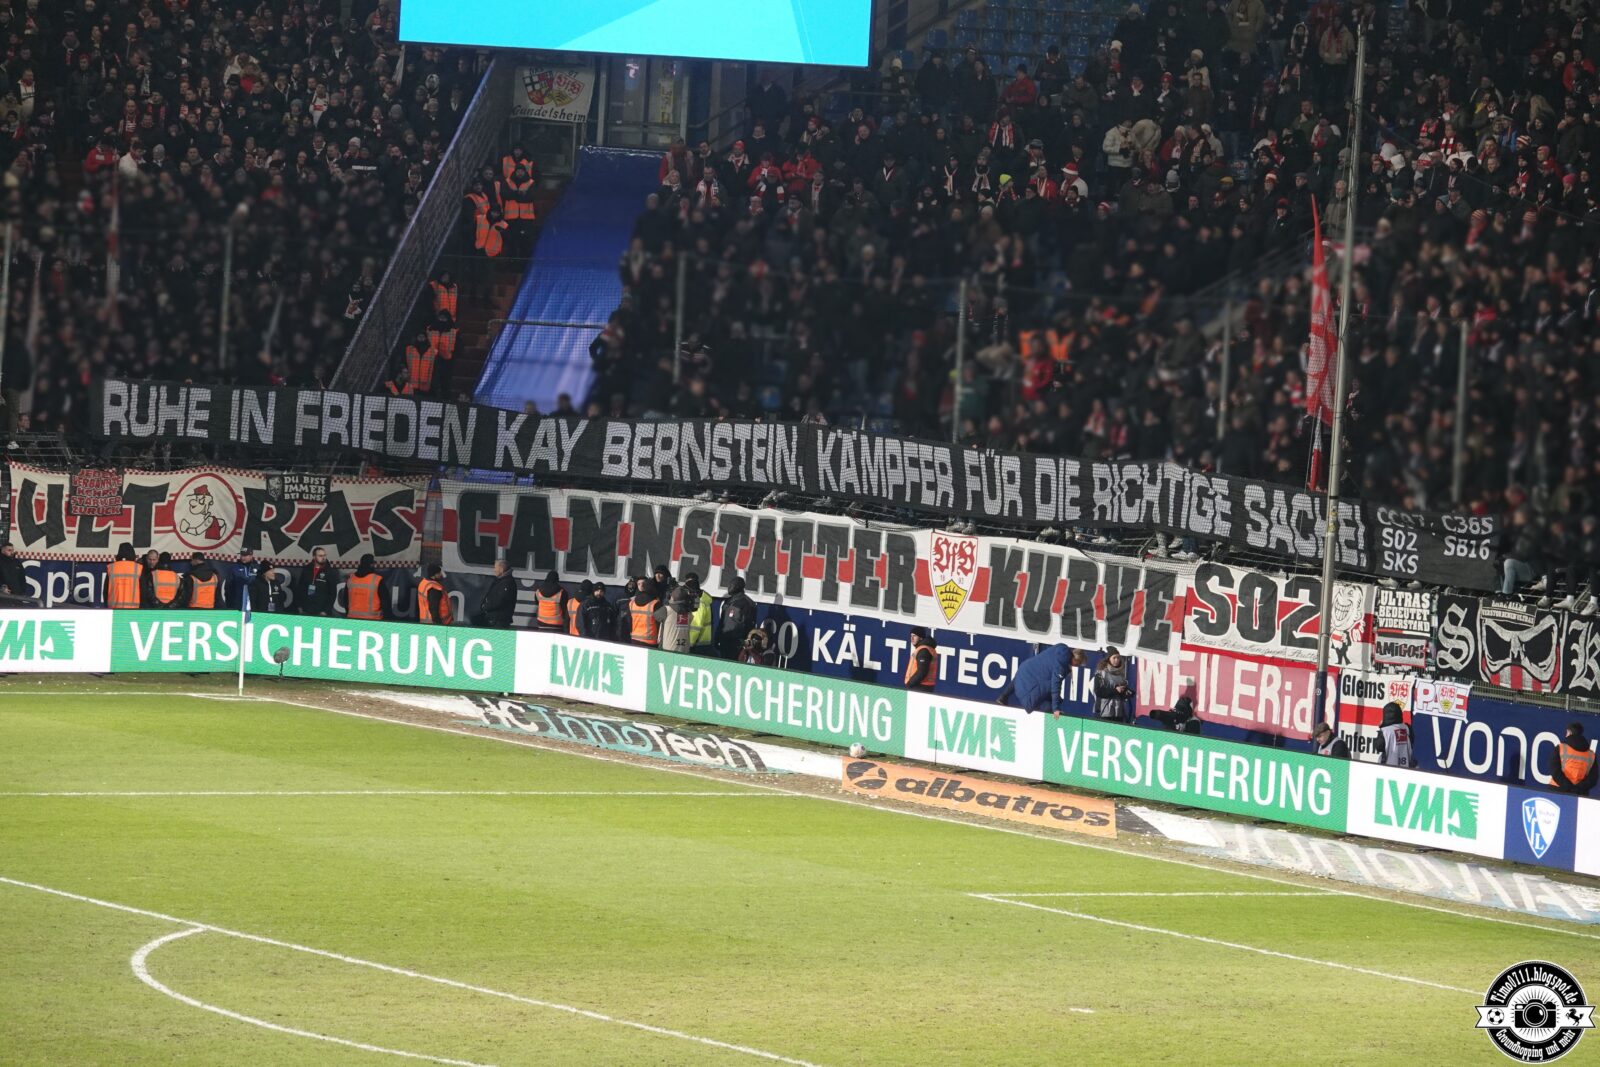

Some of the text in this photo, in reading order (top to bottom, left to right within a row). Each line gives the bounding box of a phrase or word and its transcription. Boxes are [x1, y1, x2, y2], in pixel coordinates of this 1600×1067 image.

[103, 380, 211, 438] RUHE
[229, 389, 276, 445] IN
[295, 390, 477, 466] FRIEDEN
[494, 414, 589, 472] KAY
[816, 429, 954, 508] KÄMPFER
[963, 449, 1023, 518] FÜR
[1035, 457, 1081, 521] DIE
[1093, 461, 1233, 537] RICHTIGE
[284, 476, 327, 485] DU BIST
[284, 484, 326, 495] IMMER
[457, 490, 918, 617] CANNSTATTER
[984, 543, 1179, 656] KURVE
[1382, 550, 1419, 575] SKS
[1379, 605, 1430, 621] BEDEUTET
[1380, 589, 1431, 609] ULTRAS
[1379, 617, 1430, 632] WIDERSTAND
[129, 620, 495, 681] VERSICHERUNG
[550, 643, 601, 692] LVM
[658, 662, 893, 742] VERSICHERUNG
[1342, 674, 1385, 700] Glems
[927, 705, 989, 760] LVM
[1057, 727, 1332, 816] VERSICHERUNG
[894, 776, 1111, 828] albatros
[1373, 777, 1445, 835] LVM
